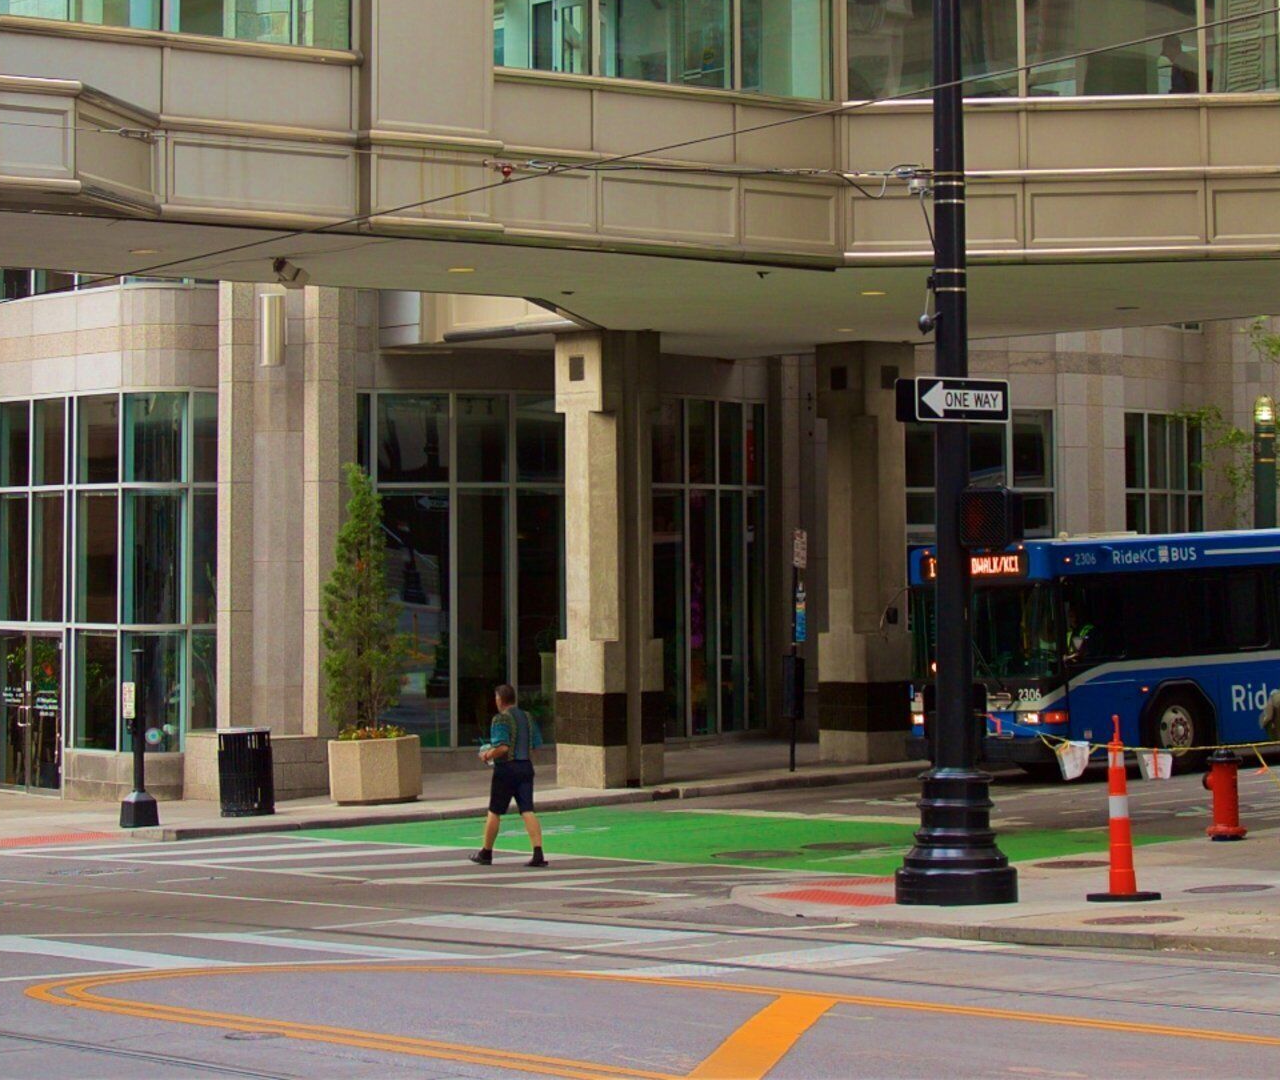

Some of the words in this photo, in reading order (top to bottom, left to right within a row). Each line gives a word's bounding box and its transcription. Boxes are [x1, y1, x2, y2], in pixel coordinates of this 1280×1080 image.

[944, 391, 970, 408] ONE
[973, 392, 999, 409] WAY
[1074, 552, 1097, 566] 2306
[1112, 547, 1156, 564] RideKC
[1170, 546, 1197, 561] BUS
[1018, 688, 1041, 701] 2306
